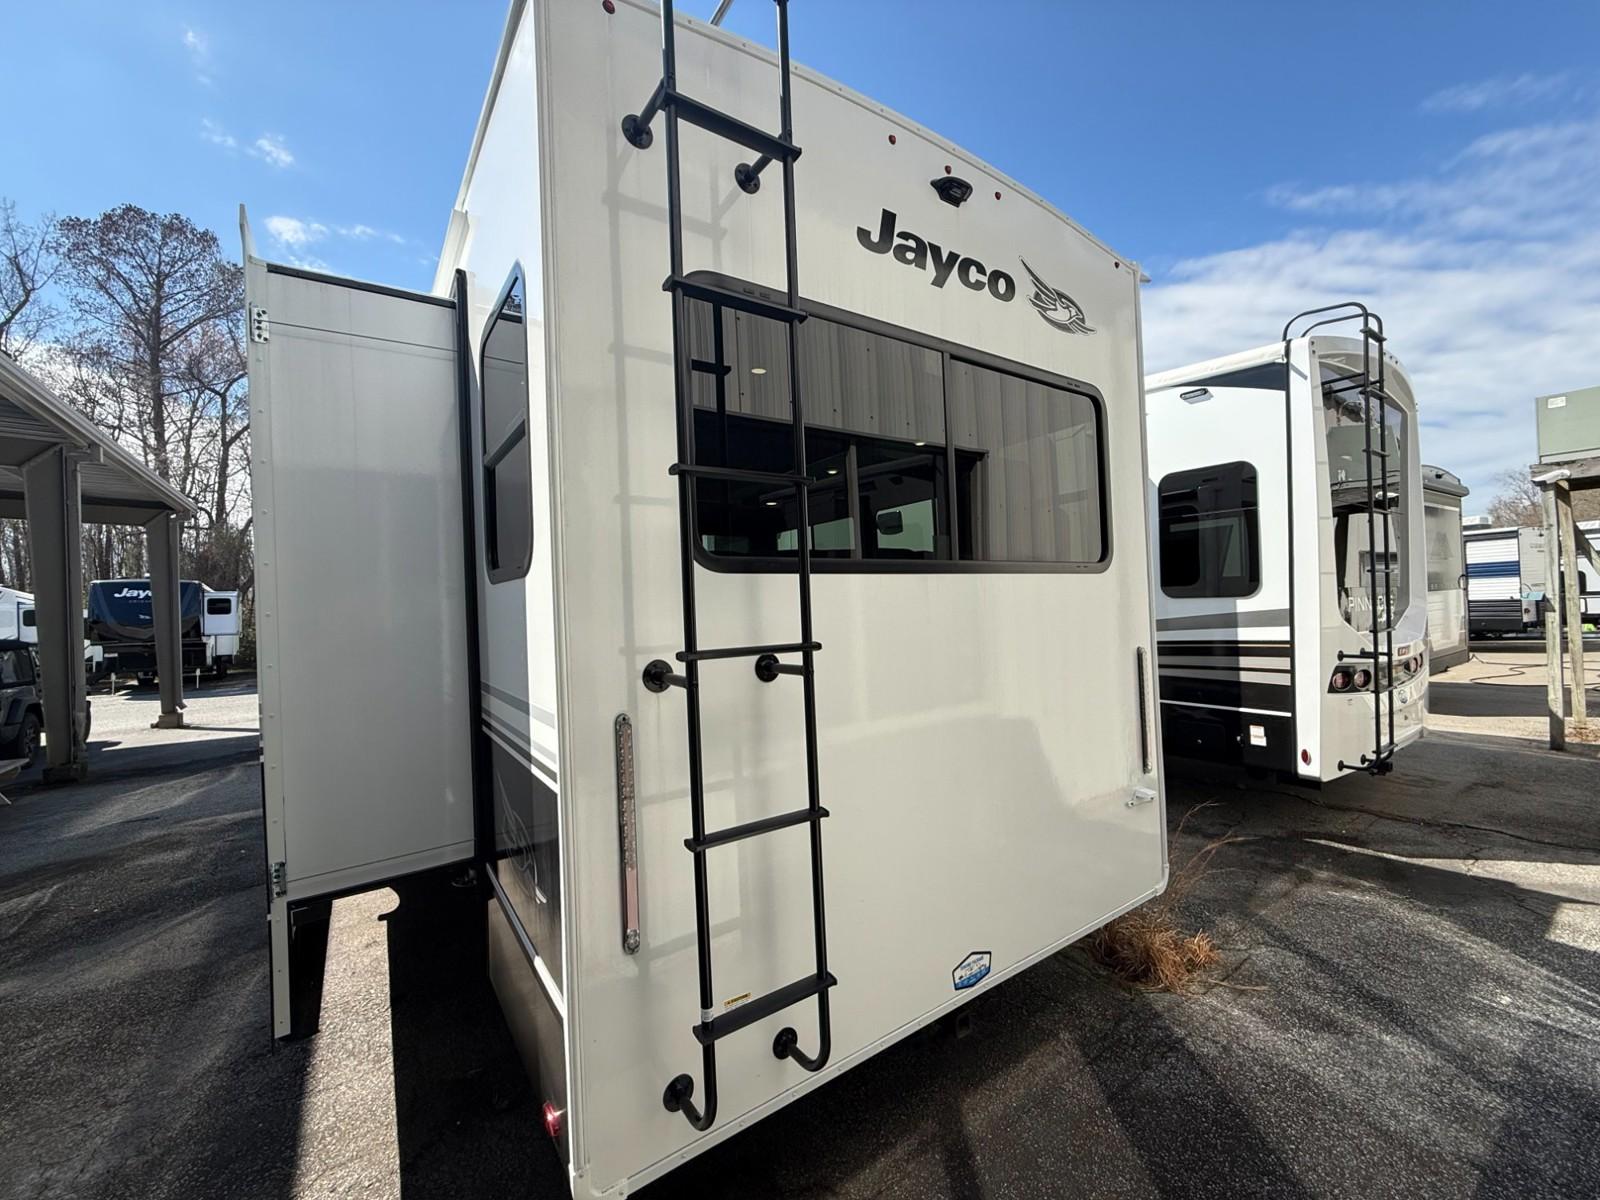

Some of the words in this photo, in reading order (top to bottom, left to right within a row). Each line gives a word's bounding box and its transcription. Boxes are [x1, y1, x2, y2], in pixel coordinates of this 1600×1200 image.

[857, 208, 1016, 302] Jayco
[113, 587, 152, 599] Jay
[1348, 595, 1395, 612] PINNCLE
